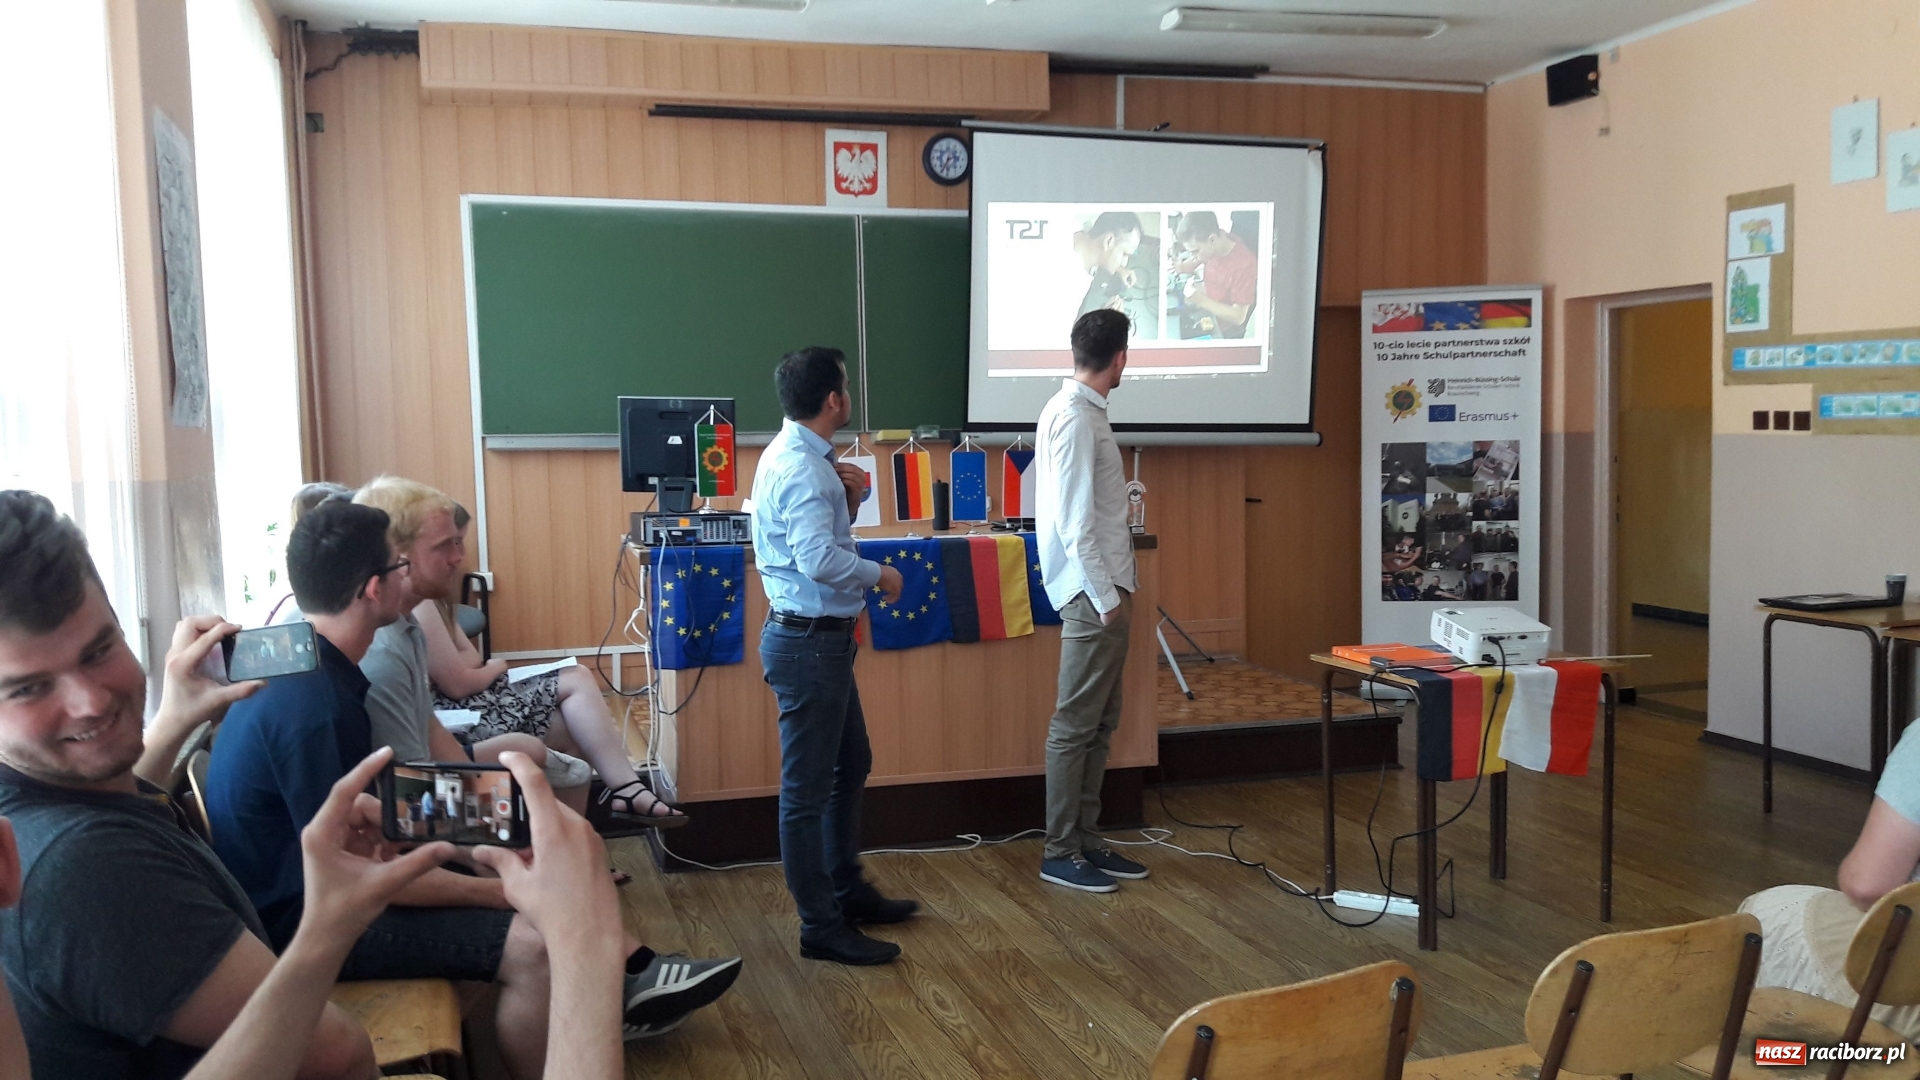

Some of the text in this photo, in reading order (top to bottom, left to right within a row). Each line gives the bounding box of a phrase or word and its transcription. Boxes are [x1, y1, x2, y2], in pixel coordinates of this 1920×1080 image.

[1373, 336, 1531, 350] 10-cio lecie partnerstwa szkół
[1376, 348, 1526, 361] 10 Jahre Schulpartnerschaft
[1459, 411, 1520, 422] Erasmus+
